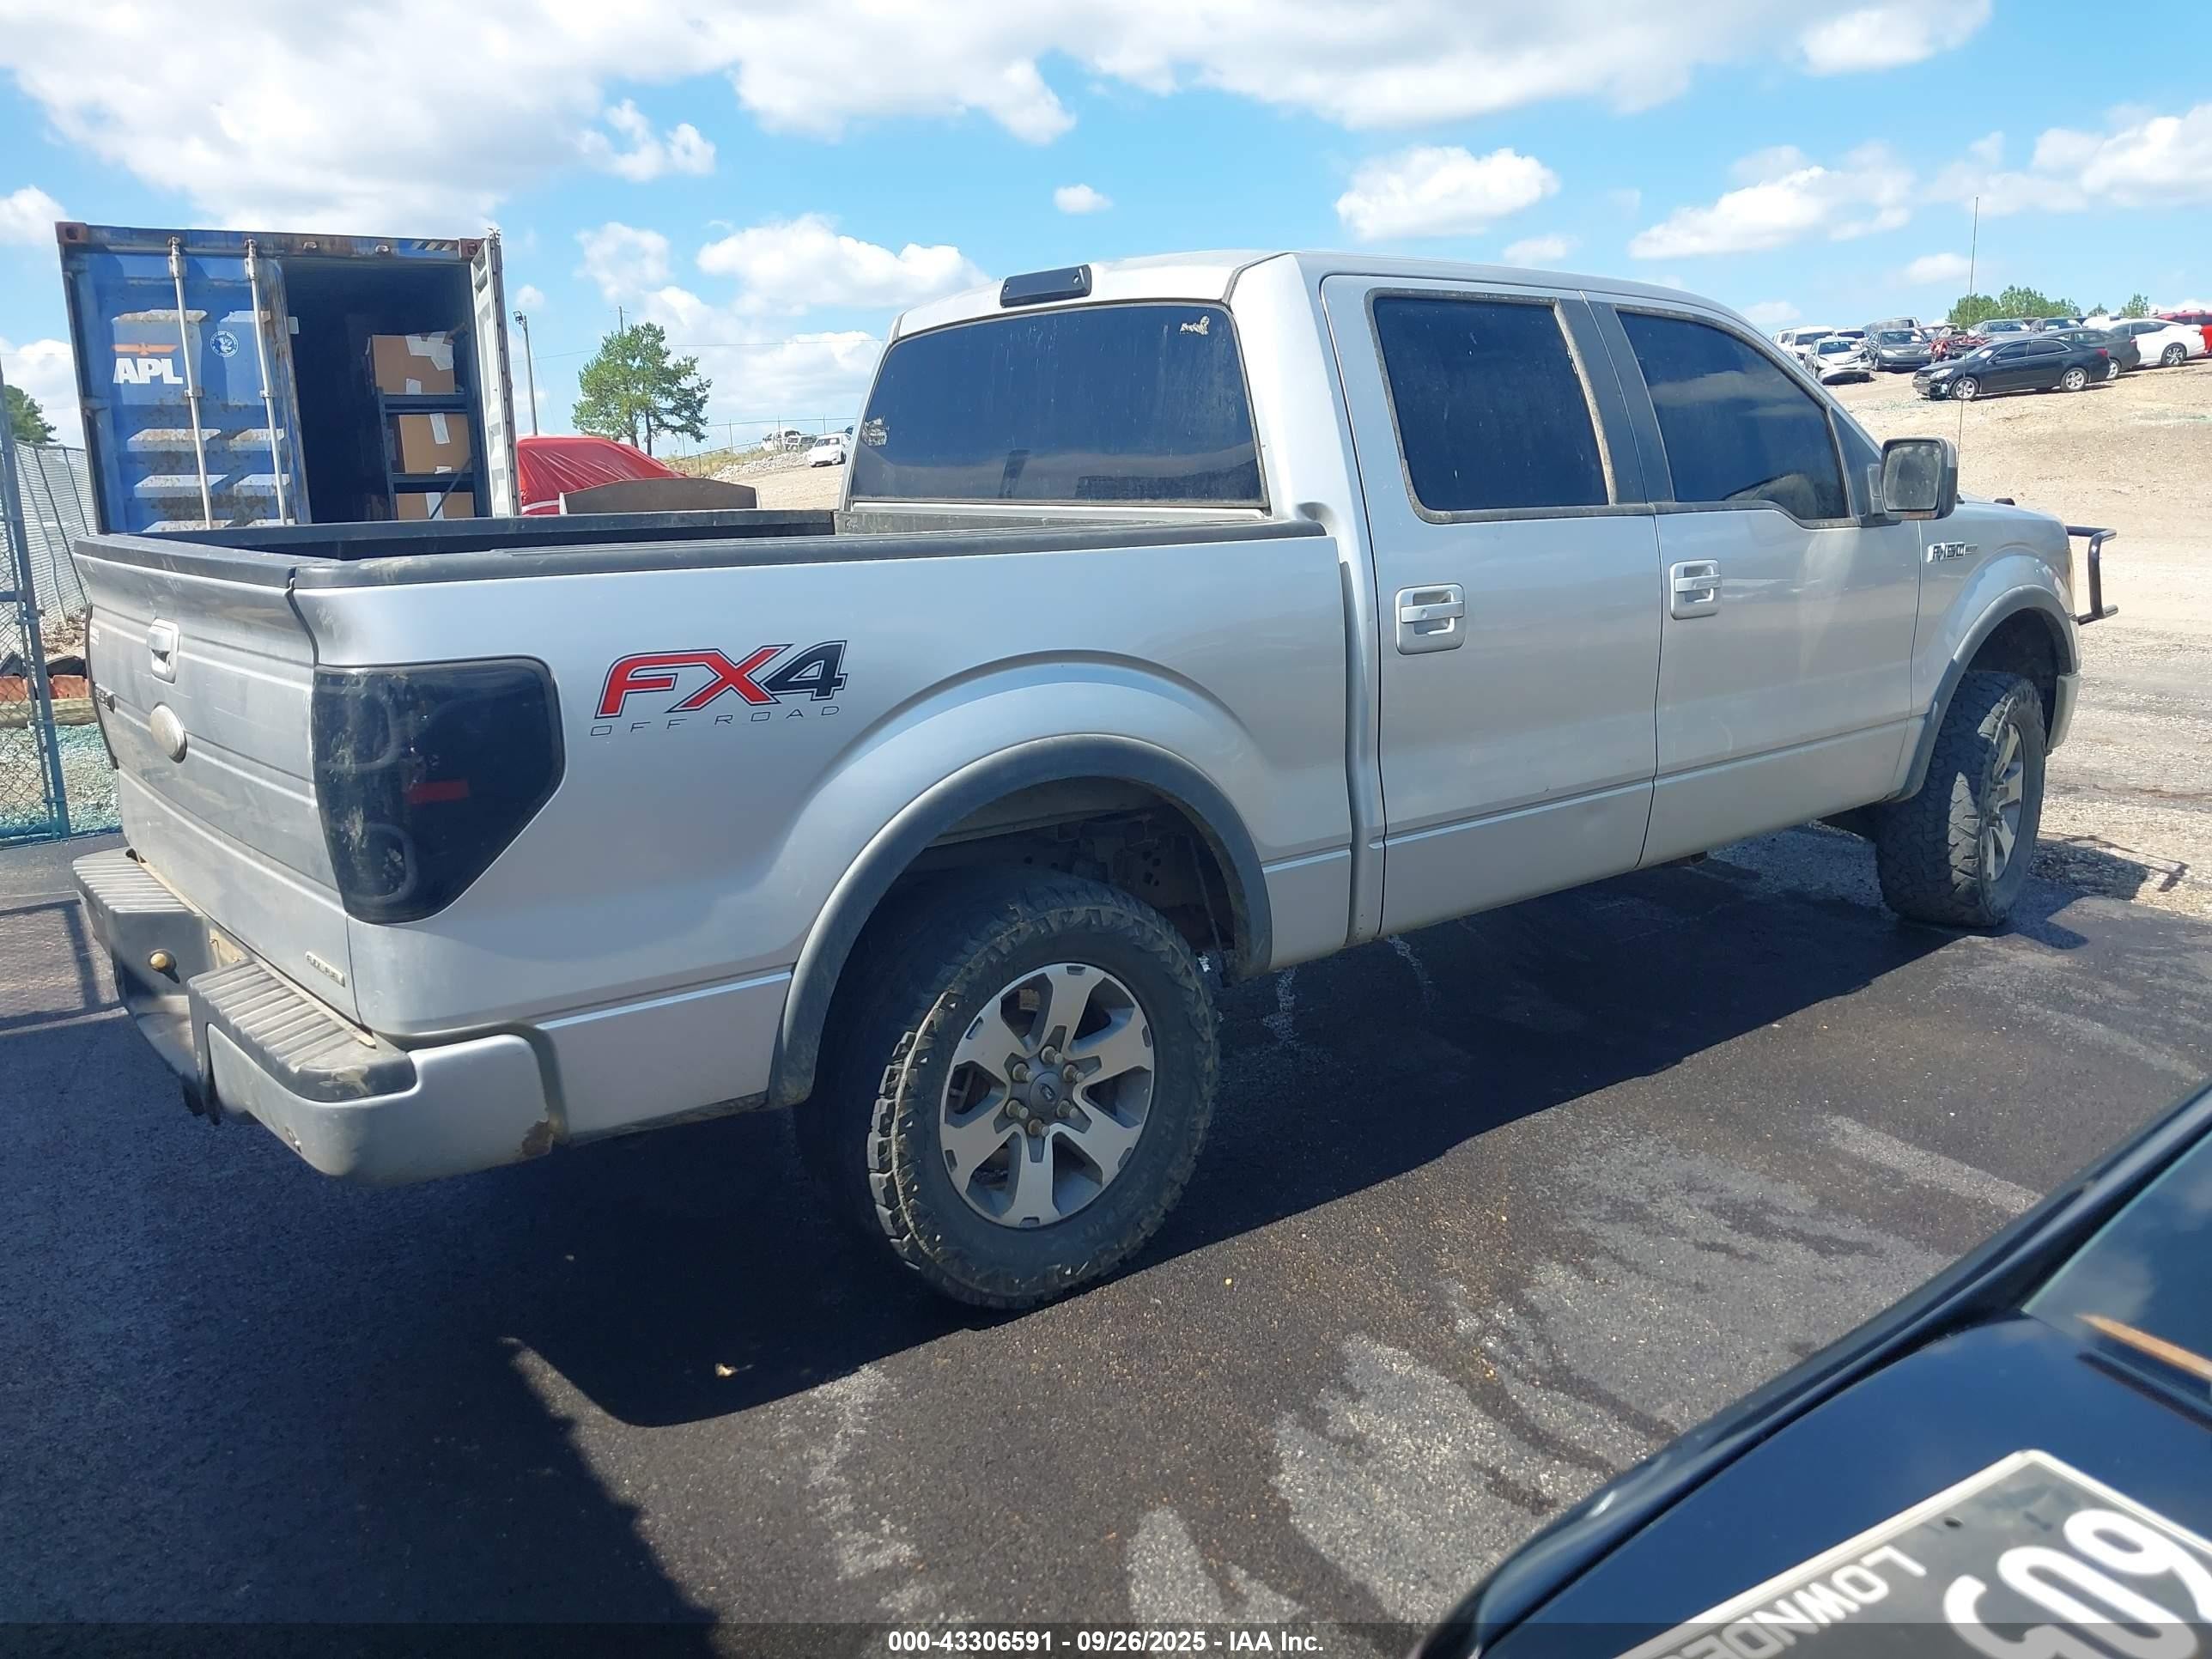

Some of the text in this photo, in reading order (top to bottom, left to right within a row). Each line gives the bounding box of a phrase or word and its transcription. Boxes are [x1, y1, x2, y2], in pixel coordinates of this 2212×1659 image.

[113, 357, 184, 385] APL
[594, 640, 848, 719] FX4
[590, 705, 840, 737] OFF ROAD
[1660, 1545, 1928, 1659] LOWNDE
